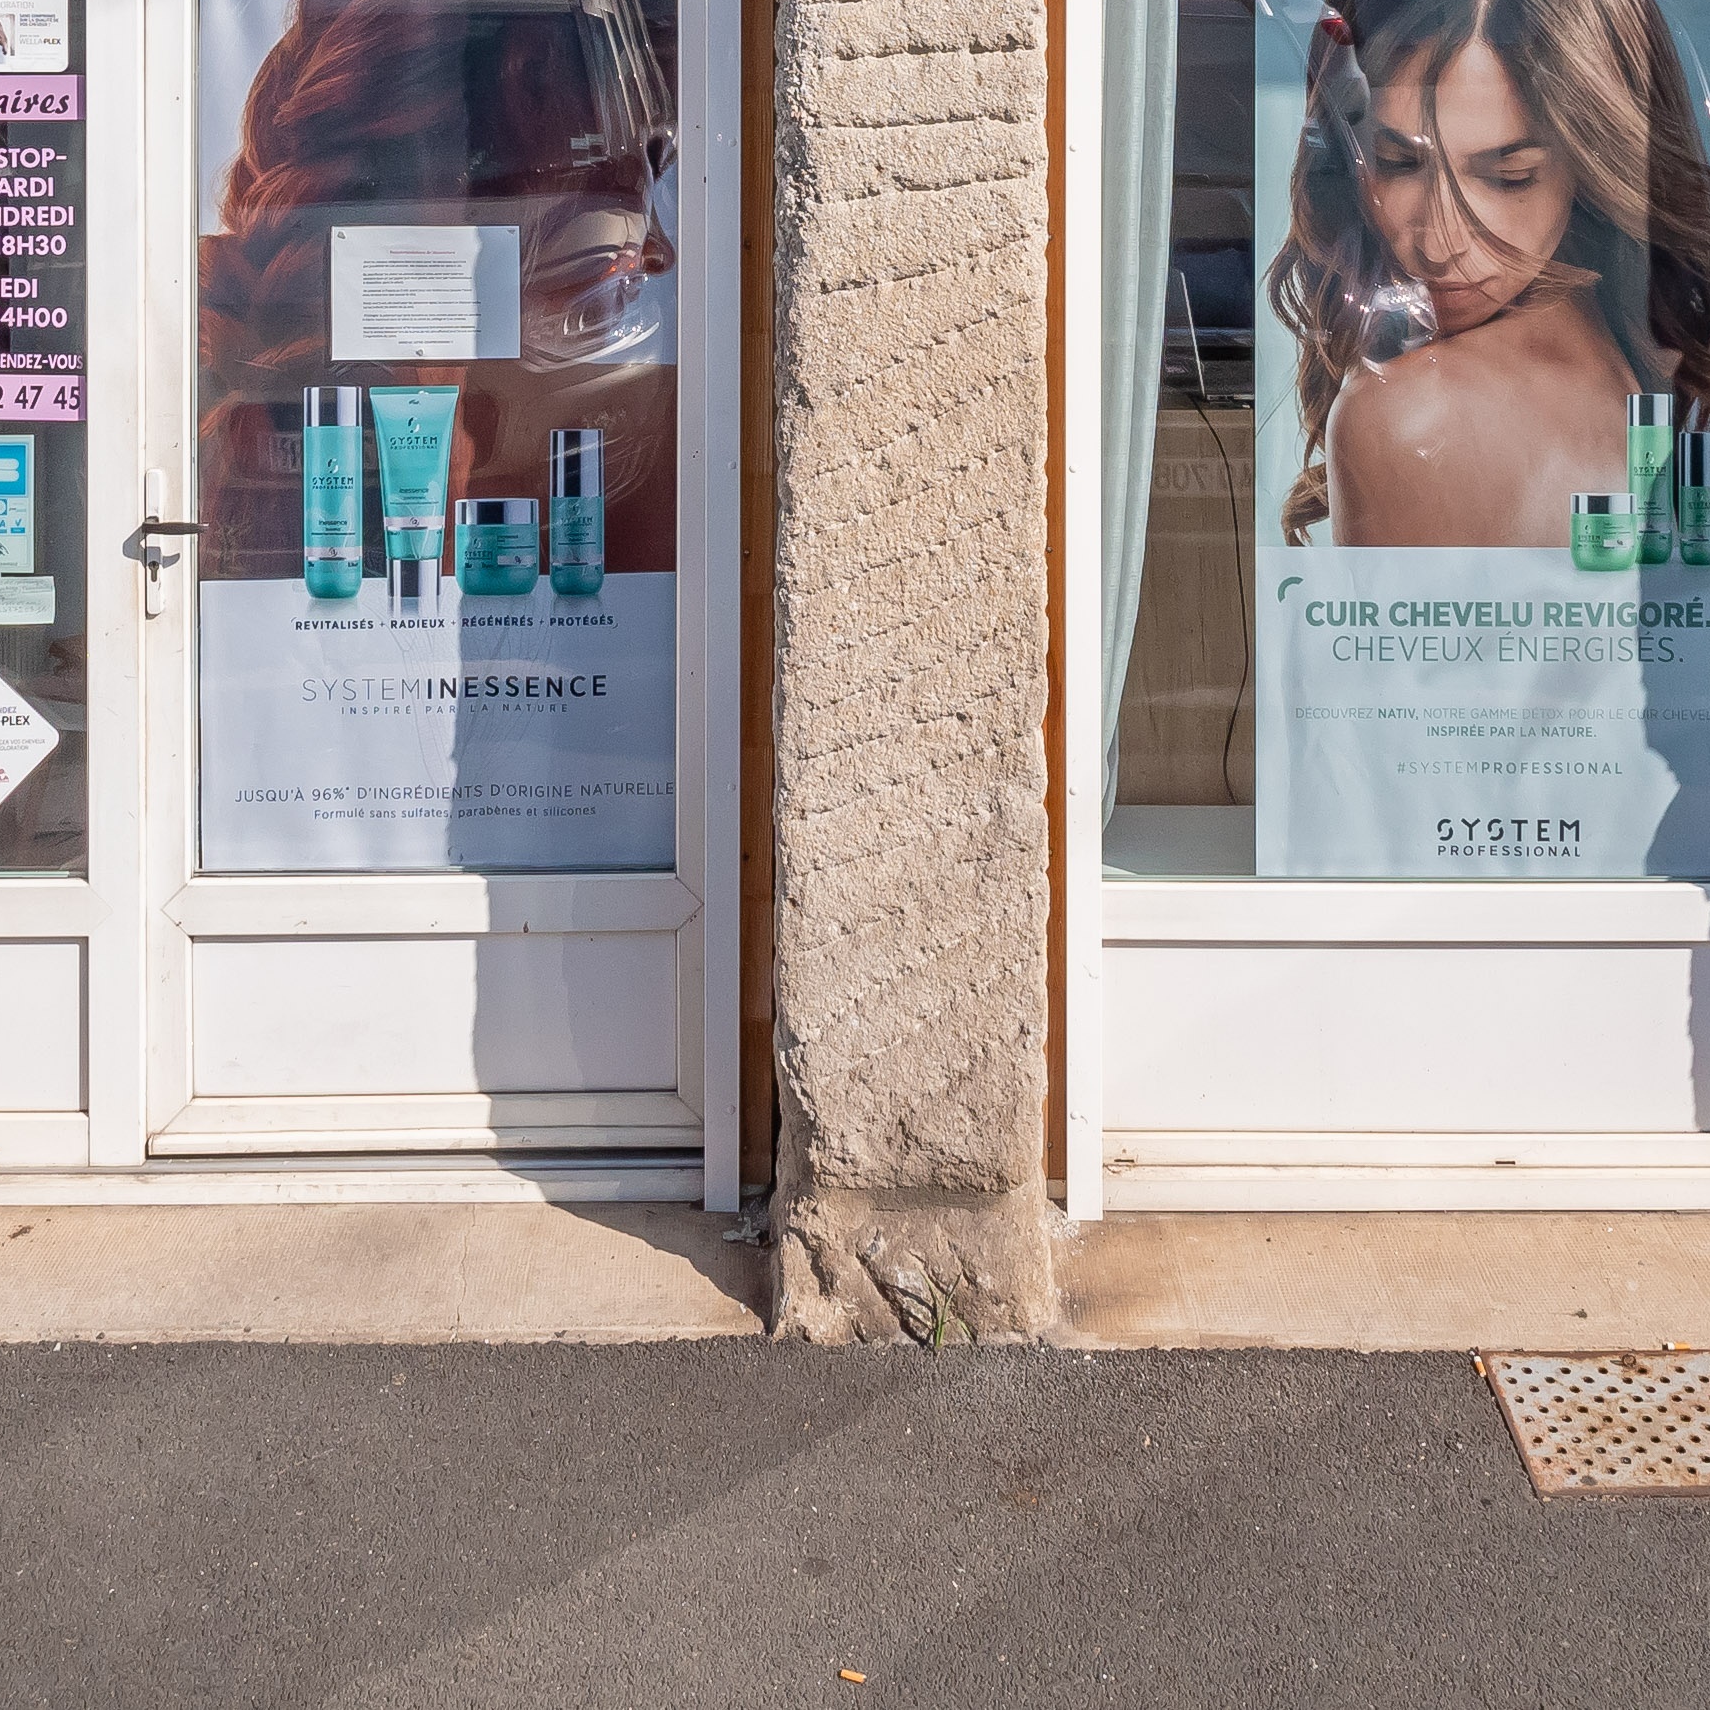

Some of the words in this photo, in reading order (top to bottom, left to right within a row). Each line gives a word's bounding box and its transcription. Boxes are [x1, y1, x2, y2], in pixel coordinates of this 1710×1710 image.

[15, 385, 43, 409] 47
[53, 385, 81, 410] 45
[390, 436, 438, 445] SYSTEM
[312, 477, 353, 485] SYSTEM
[1305, 600, 1379, 628] CUIR
[1389, 600, 1533, 628] CHEVELU
[295, 618, 374, 631] REVITALISÉS
[390, 618, 445, 630] RADIEUX
[461, 615, 534, 628] RÉGÉNÉRÉS
[549, 614, 614, 627] PROTÉGÉS
[1332, 635, 1483, 662] CHEVEUX
[1499, 631, 1685, 663] ÉNERGISÉS.
[341, 703, 412, 715] INSPIRÉ
[425, 704, 457, 714] PAR
[470, 703, 489, 713] LA
[502, 703, 569, 713] NATURE
[1378, 708, 1419, 721] NATIV,
[1423, 708, 1466, 720] NOTRE
[1470, 708, 1518, 720] GAMME
[1569, 708, 1605, 720] POUR
[1609, 708, 1624, 720] LE
[1628, 708, 1658, 720] CUIR
[1426, 723, 1484, 738] INSPIRÉE
[1490, 726, 1515, 738] PAR
[1520, 726, 1537, 738] LA
[1541, 726, 1597, 738] NATURE.
[1396, 761, 1623, 775] #SYSTEMPROFESSIONAL
[235, 786, 305, 803] JUSQU'À
[357, 783, 483, 801] D'INGRÉDIENTS
[490, 782, 573, 798] D'ORIGINE
[580, 781, 674, 797] NATURELLE
[314, 808, 365, 820] Formulé
[369, 809, 397, 820] sans
[458, 804, 522, 819] parabènes
[527, 806, 538, 817] et
[543, 804, 596, 817] silicones
[1437, 818, 1581, 842] SYSTEM
[1437, 845, 1581, 858] PROFESSIONAL
